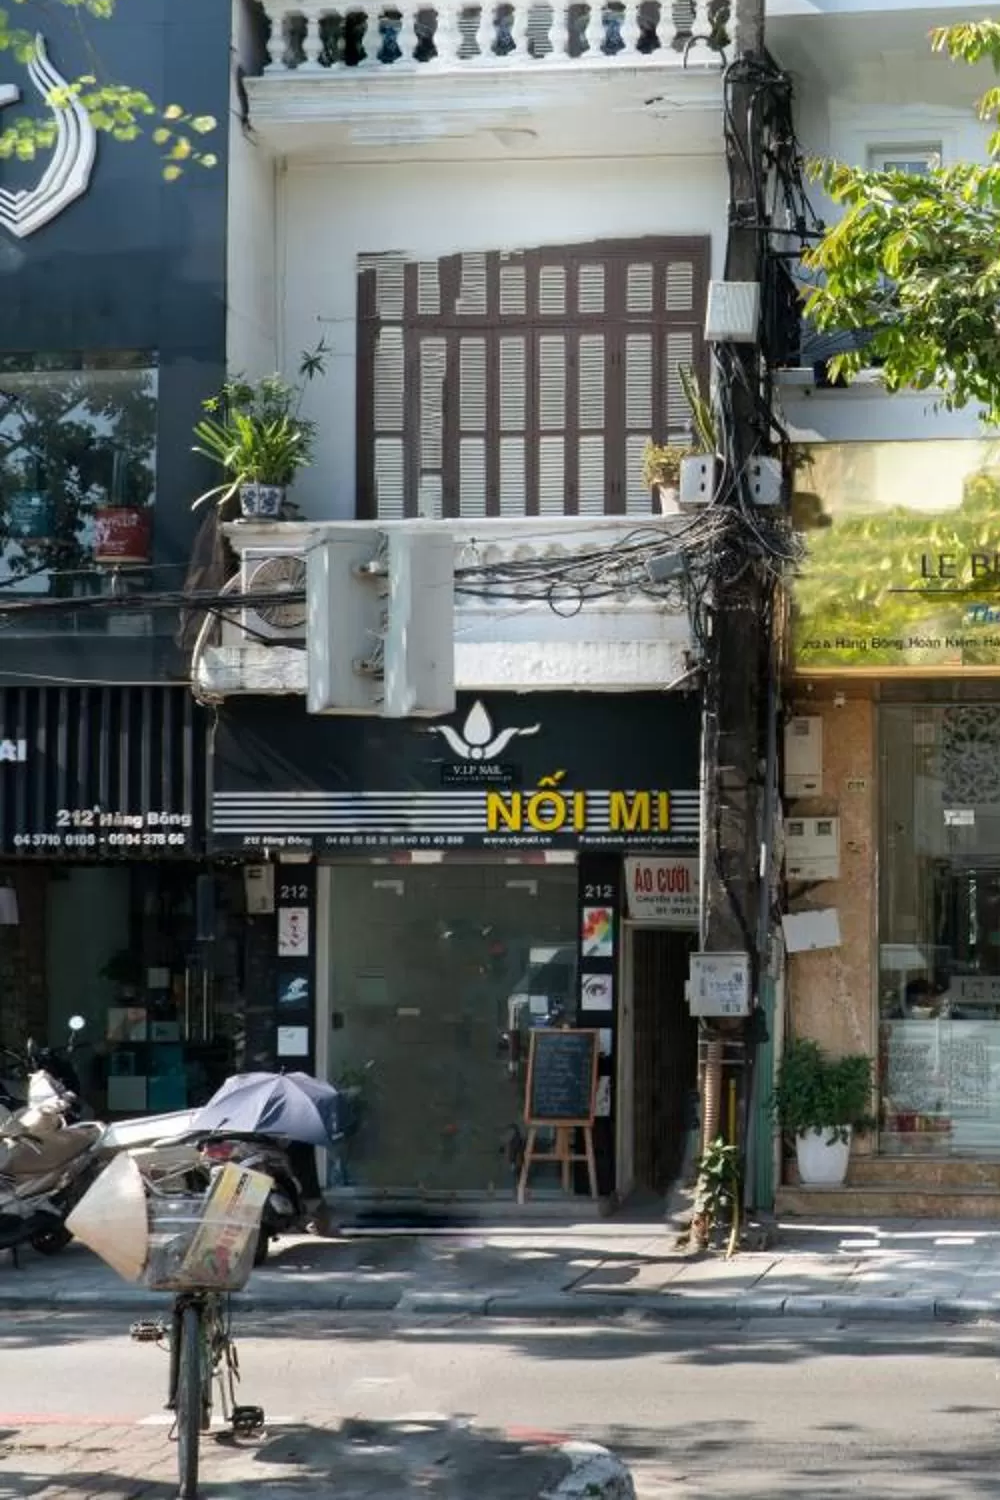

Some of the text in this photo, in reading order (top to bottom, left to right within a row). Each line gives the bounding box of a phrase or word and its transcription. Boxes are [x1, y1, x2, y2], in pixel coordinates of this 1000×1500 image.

[921, 554, 955, 579] LE
[486, 769, 670, 832] NỐI MI
[280, 884, 309, 899] 212
[584, 884, 614, 898] 212
